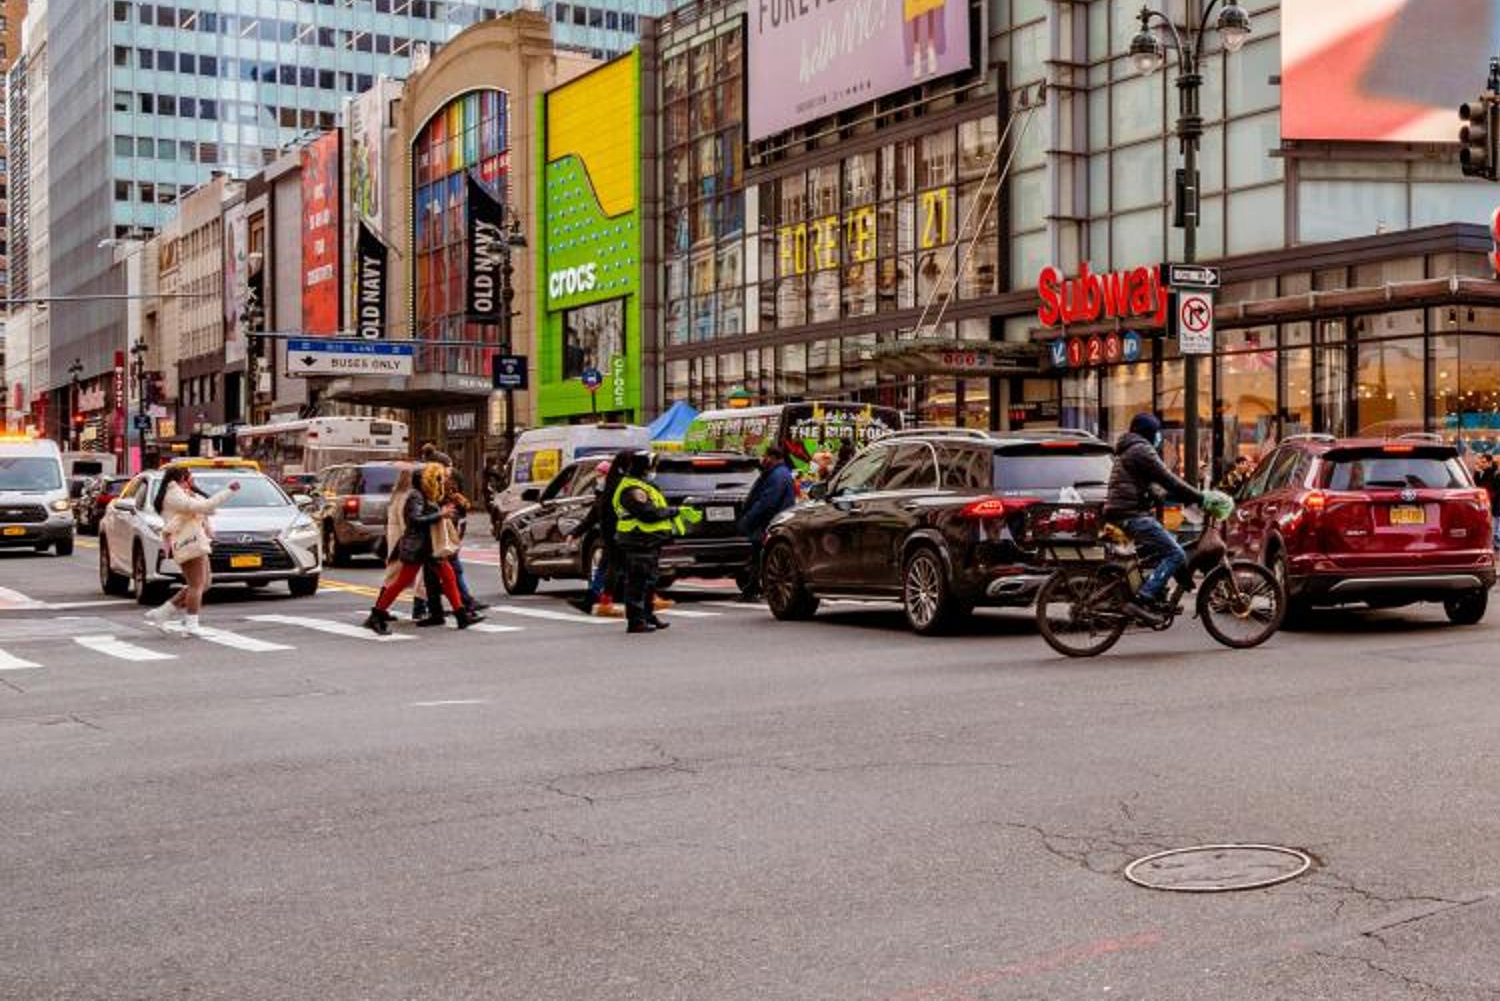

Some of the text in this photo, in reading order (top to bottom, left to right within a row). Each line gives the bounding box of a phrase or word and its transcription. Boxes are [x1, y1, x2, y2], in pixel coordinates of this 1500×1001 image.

[474, 219, 496, 312] OLD NAVY
[779, 187, 950, 278] FOREE 21
[362, 255, 382, 340] OLD NAVY
[549, 262, 598, 298] crocs
[1037, 260, 1169, 329] Subway
[331, 358, 401, 370] BUSES ONLY
[790, 426, 820, 440] THE
